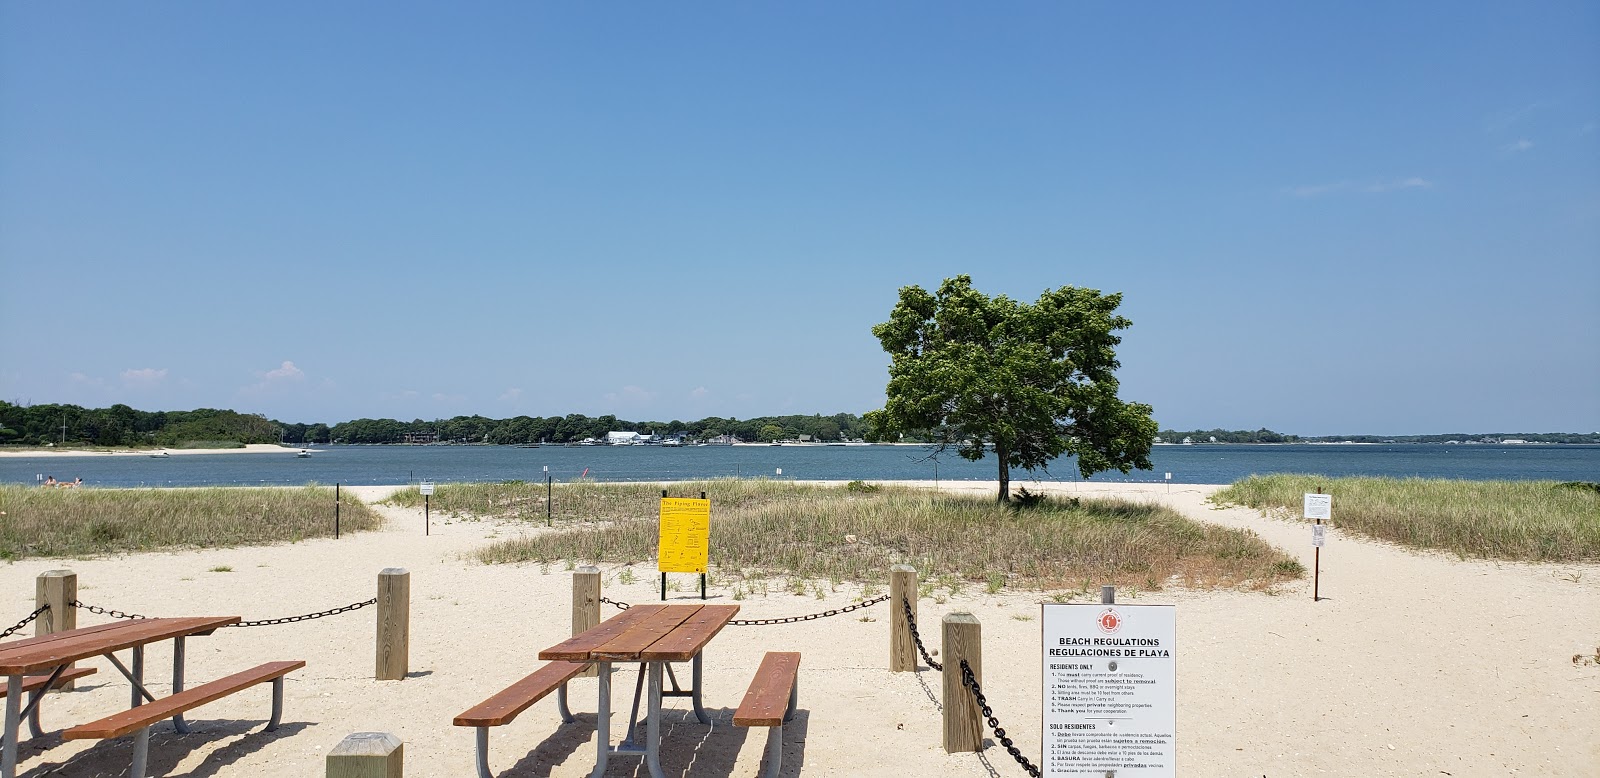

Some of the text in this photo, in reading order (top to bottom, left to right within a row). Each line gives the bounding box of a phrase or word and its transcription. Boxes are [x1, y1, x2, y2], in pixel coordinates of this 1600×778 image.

[1094, 638, 1160, 646] REGULATIONS
[1049, 649, 1169, 657] REGULACIONES DE PLAYA
